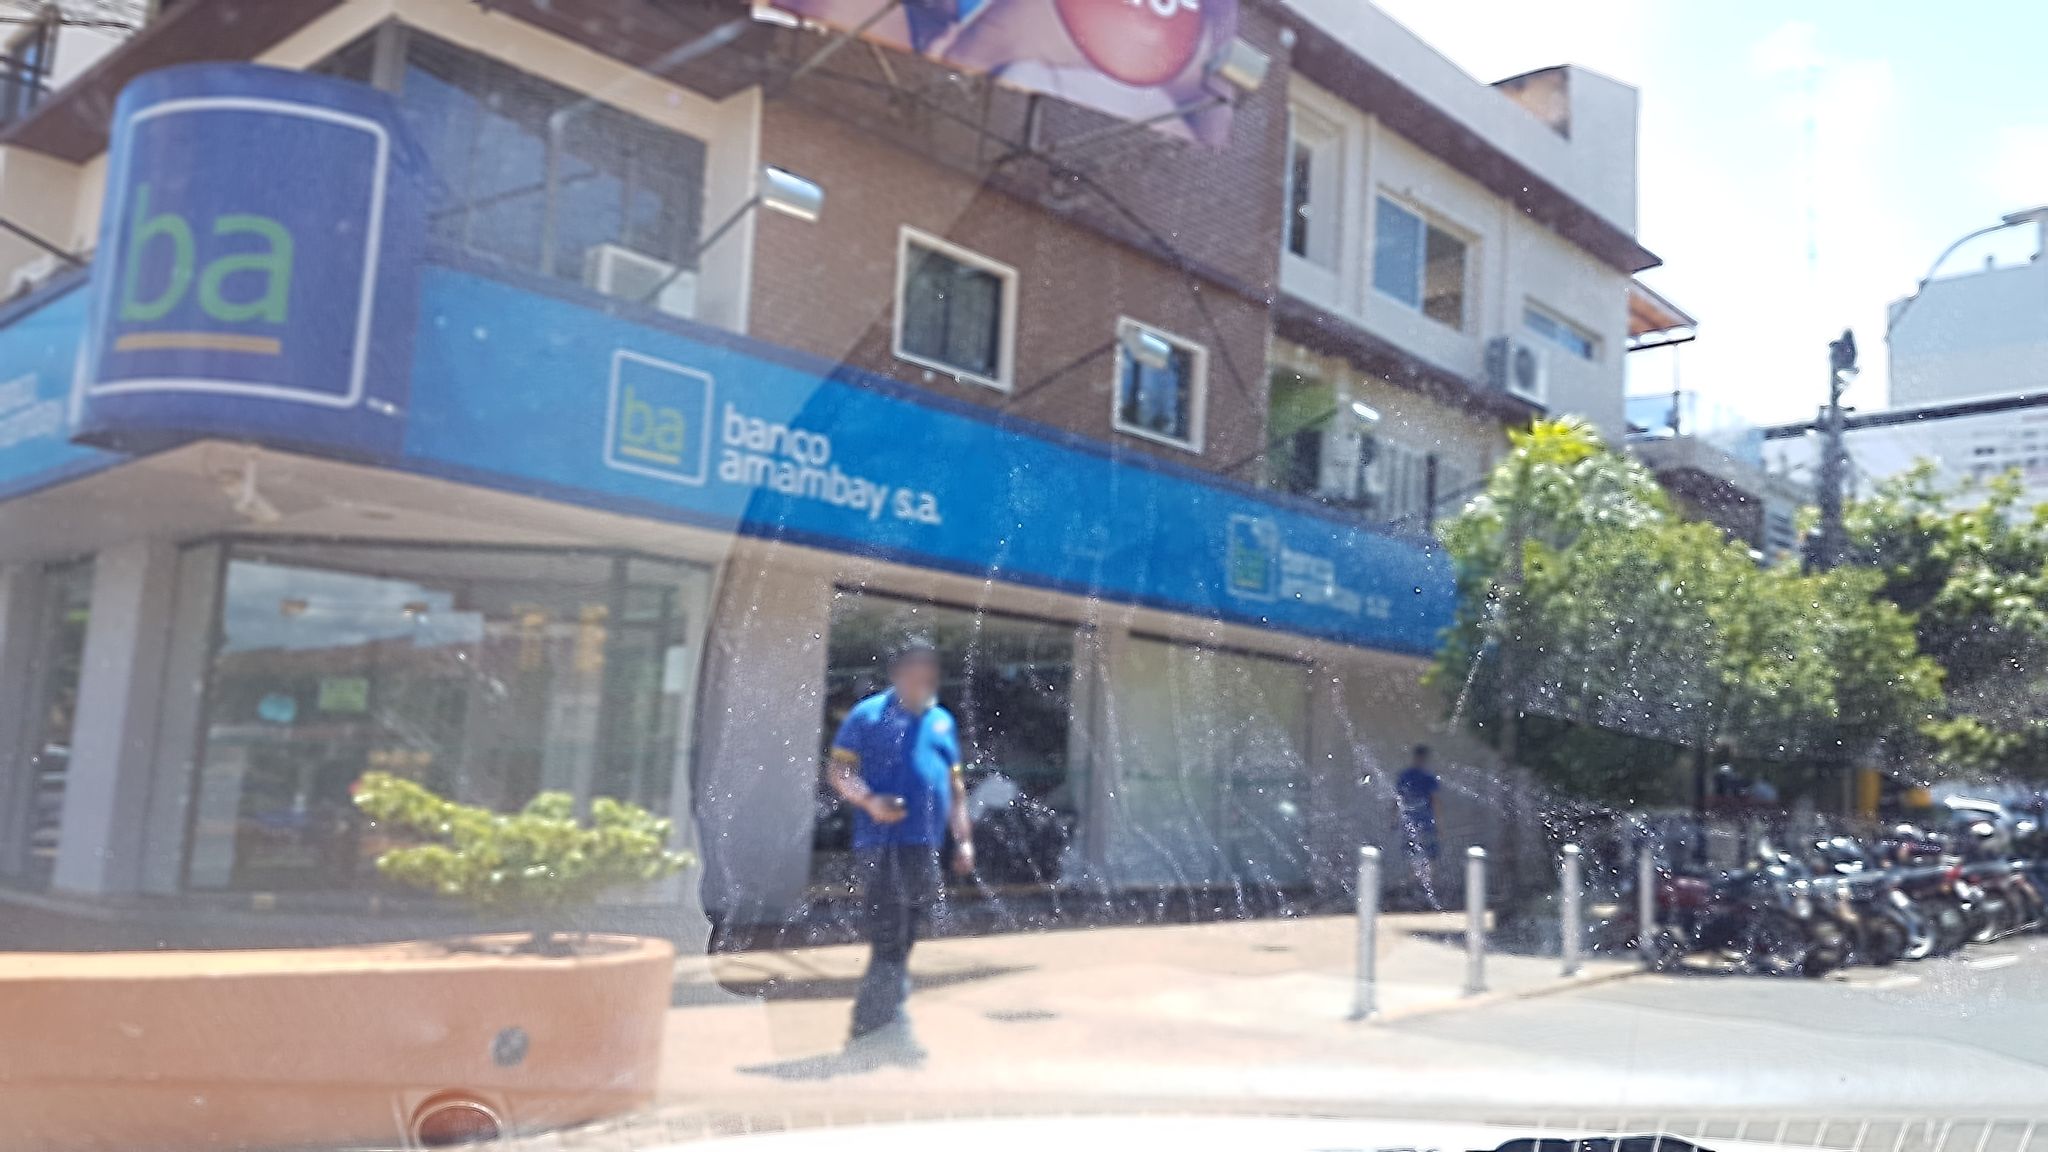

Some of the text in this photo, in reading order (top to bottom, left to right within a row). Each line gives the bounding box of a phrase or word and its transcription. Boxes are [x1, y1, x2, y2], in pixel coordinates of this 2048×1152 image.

[117, 183, 295, 324] ba
[620, 383, 685, 451] ba
[721, 401, 831, 465] banco
[718, 448, 889, 521] amambay
